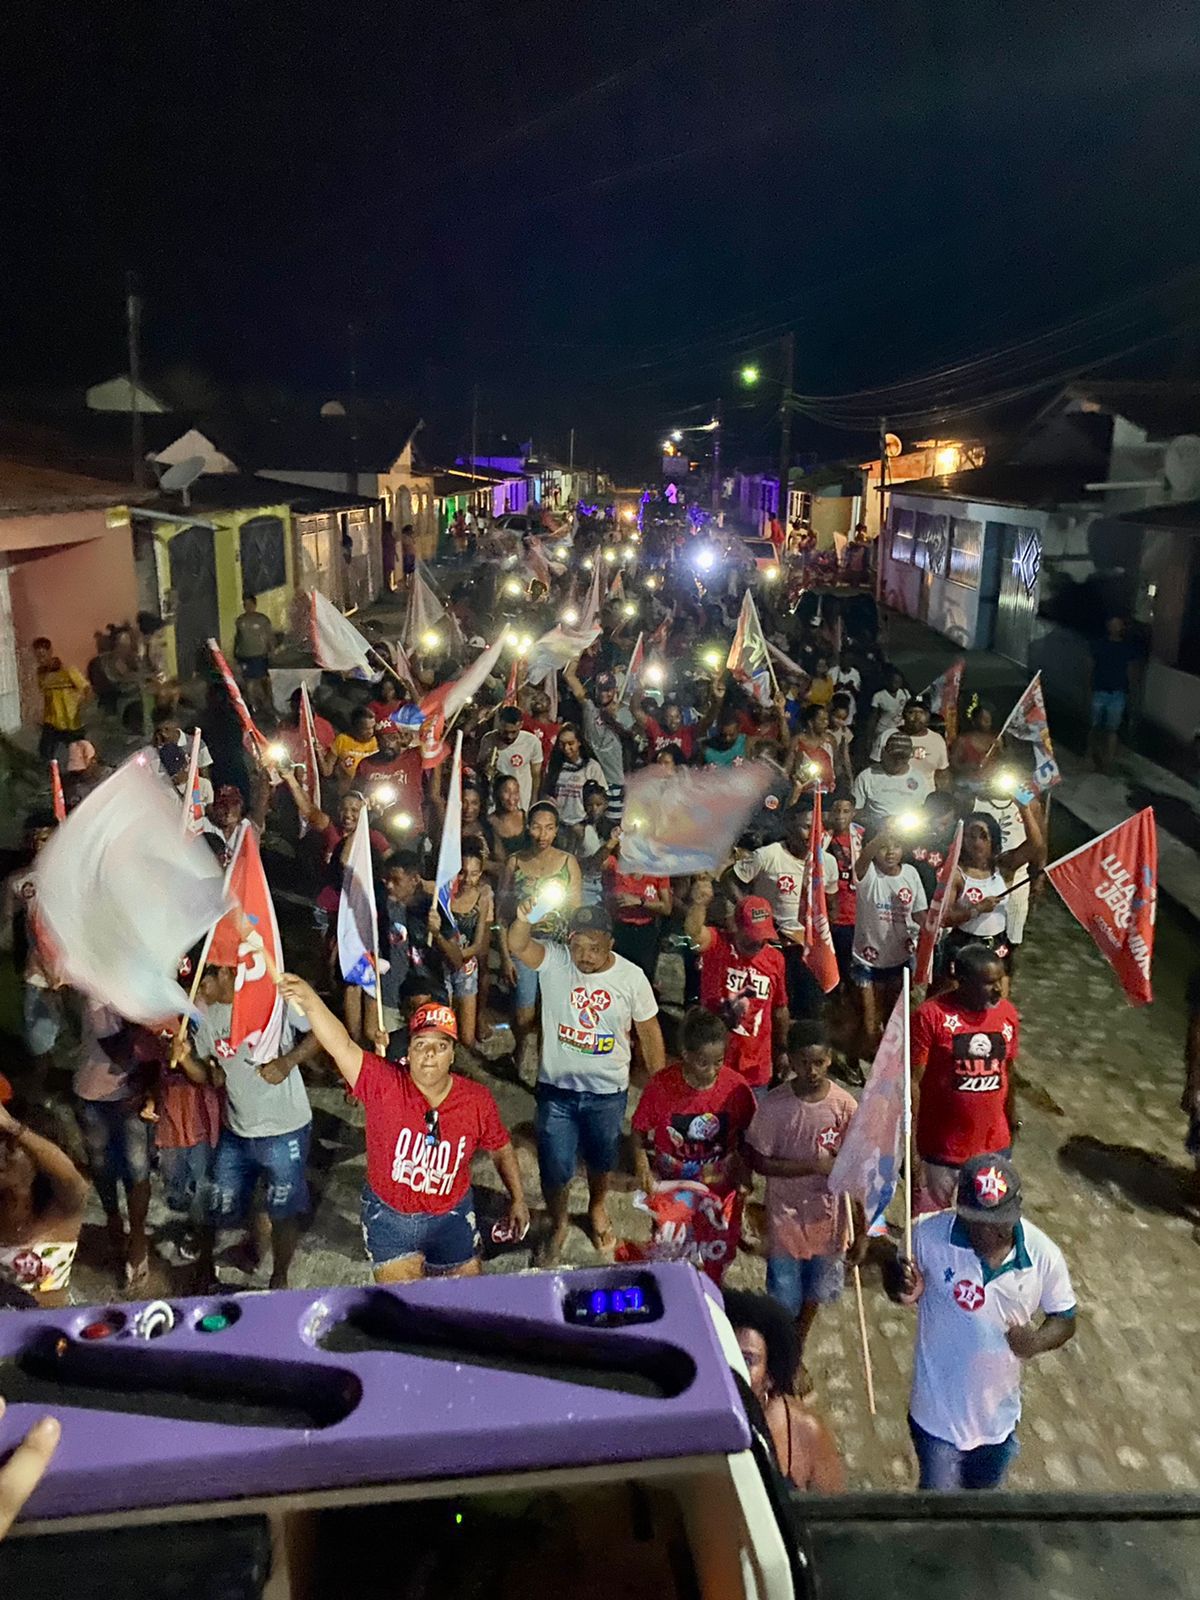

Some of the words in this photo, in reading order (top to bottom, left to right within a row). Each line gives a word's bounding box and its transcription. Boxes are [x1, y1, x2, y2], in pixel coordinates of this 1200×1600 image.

[1100, 852, 1139, 903] LULA
[598, 1037, 614, 1052] 13
[955, 1059, 1001, 1076] LULA
[958, 1075, 1000, 1092] 2022
[394, 1127, 412, 1161] O
